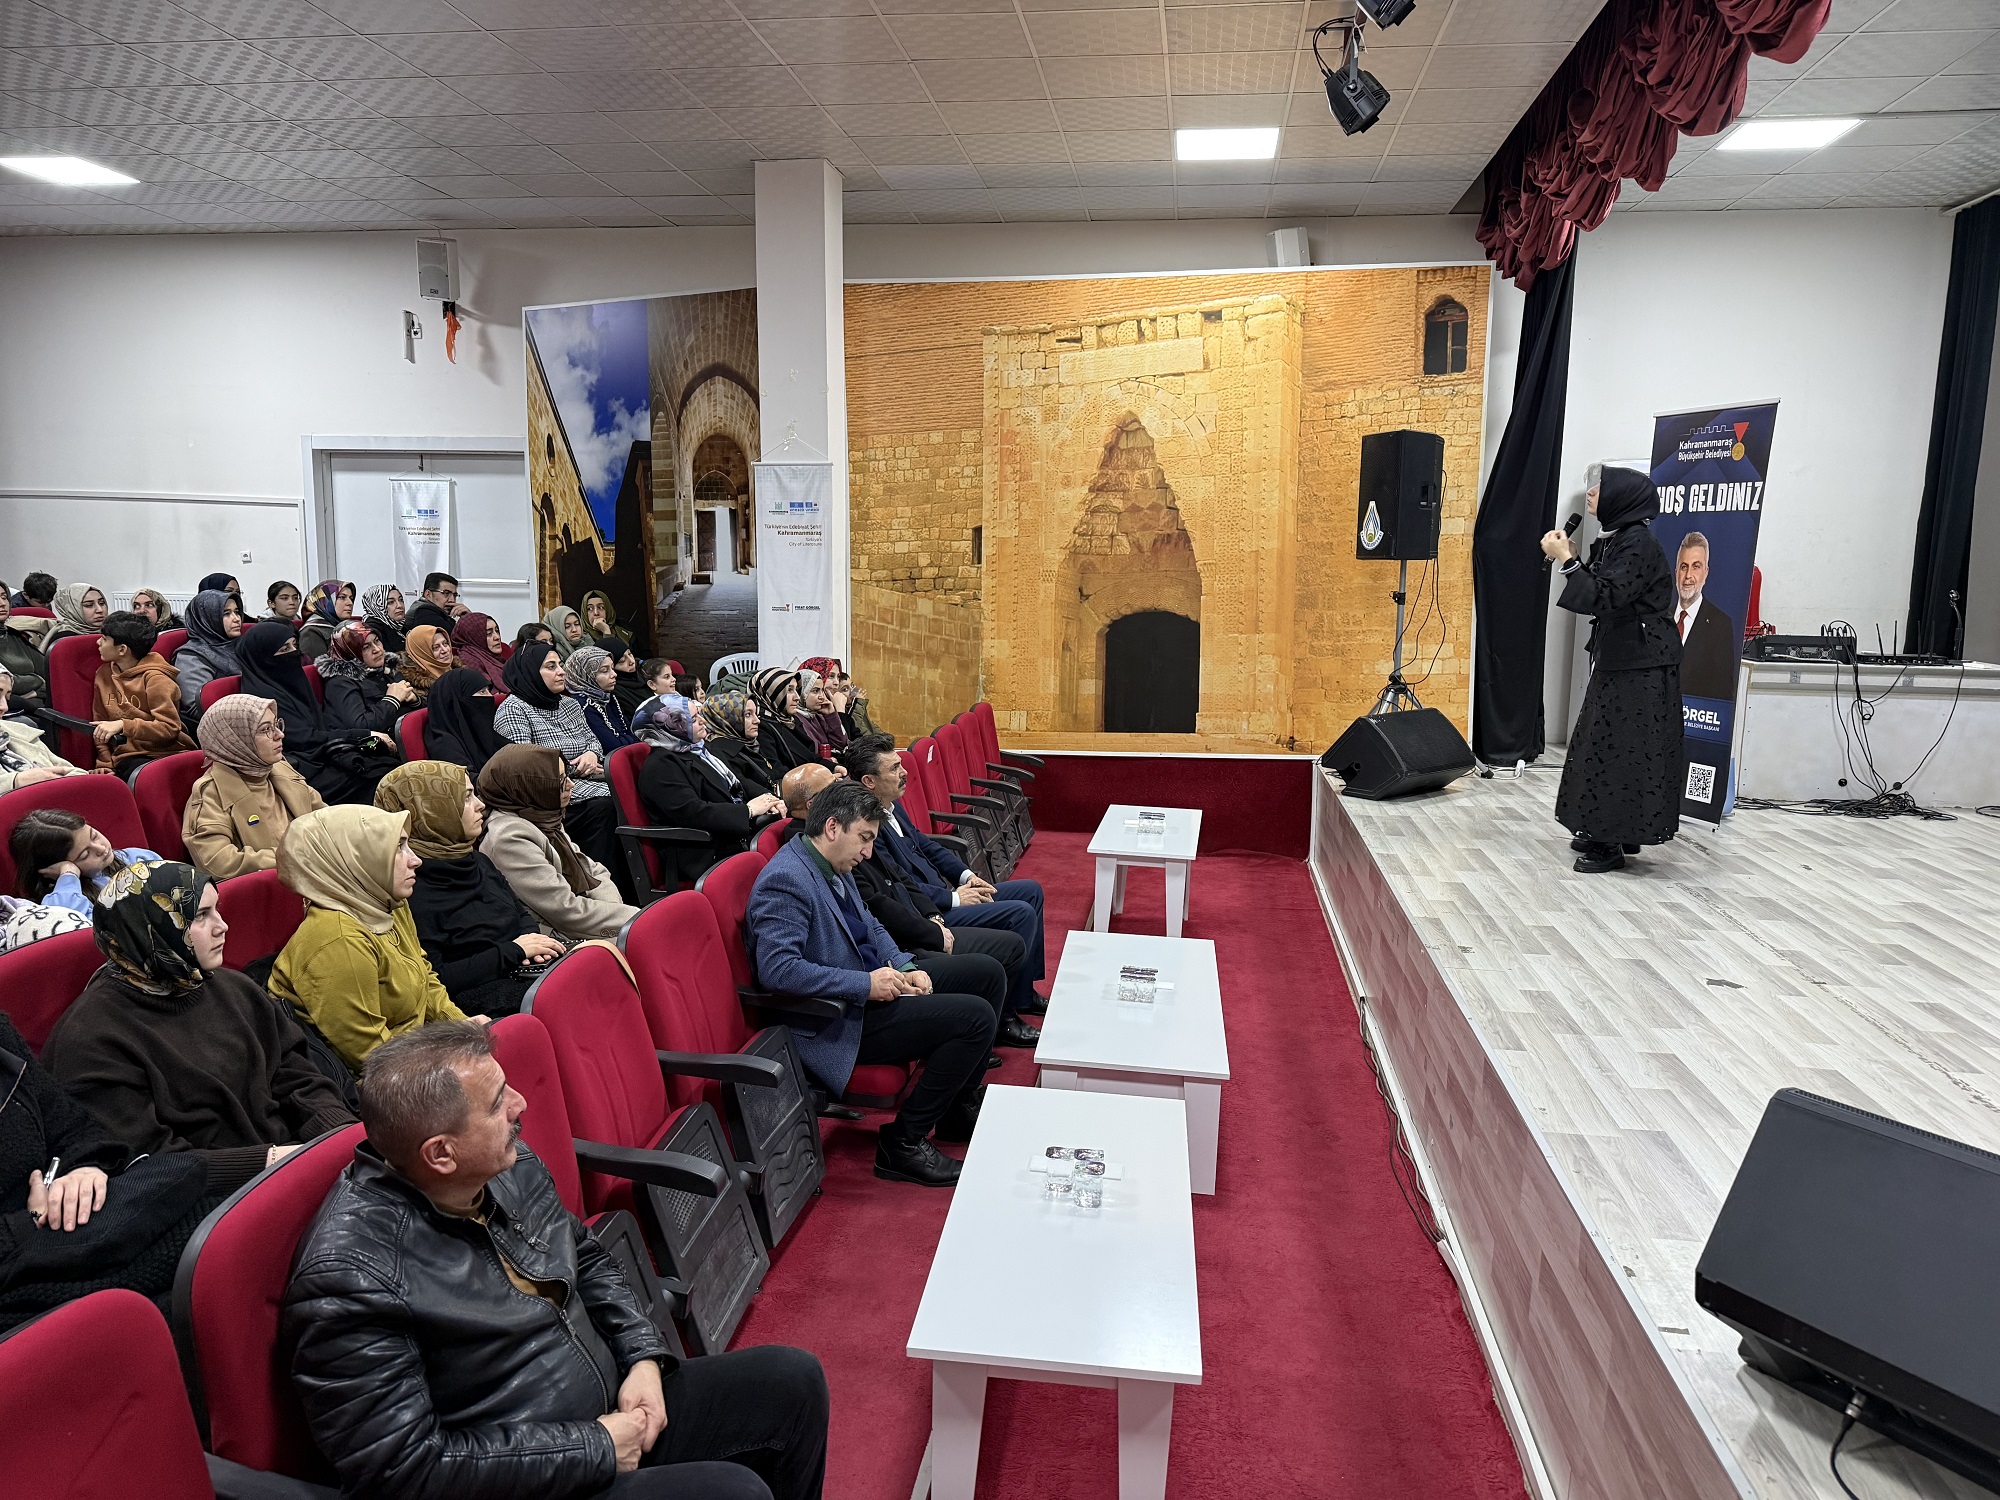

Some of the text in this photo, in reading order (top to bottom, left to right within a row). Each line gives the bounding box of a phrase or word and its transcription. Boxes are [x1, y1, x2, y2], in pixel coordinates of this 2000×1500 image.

[1679, 439, 1733, 450] Kahramanmaraş
[1678, 448, 1732, 462] Büyükşehir Belediyesi
[1688, 481, 1763, 512] GELDİNİZ
[1683, 705, 1720, 725] ÖRGEL
